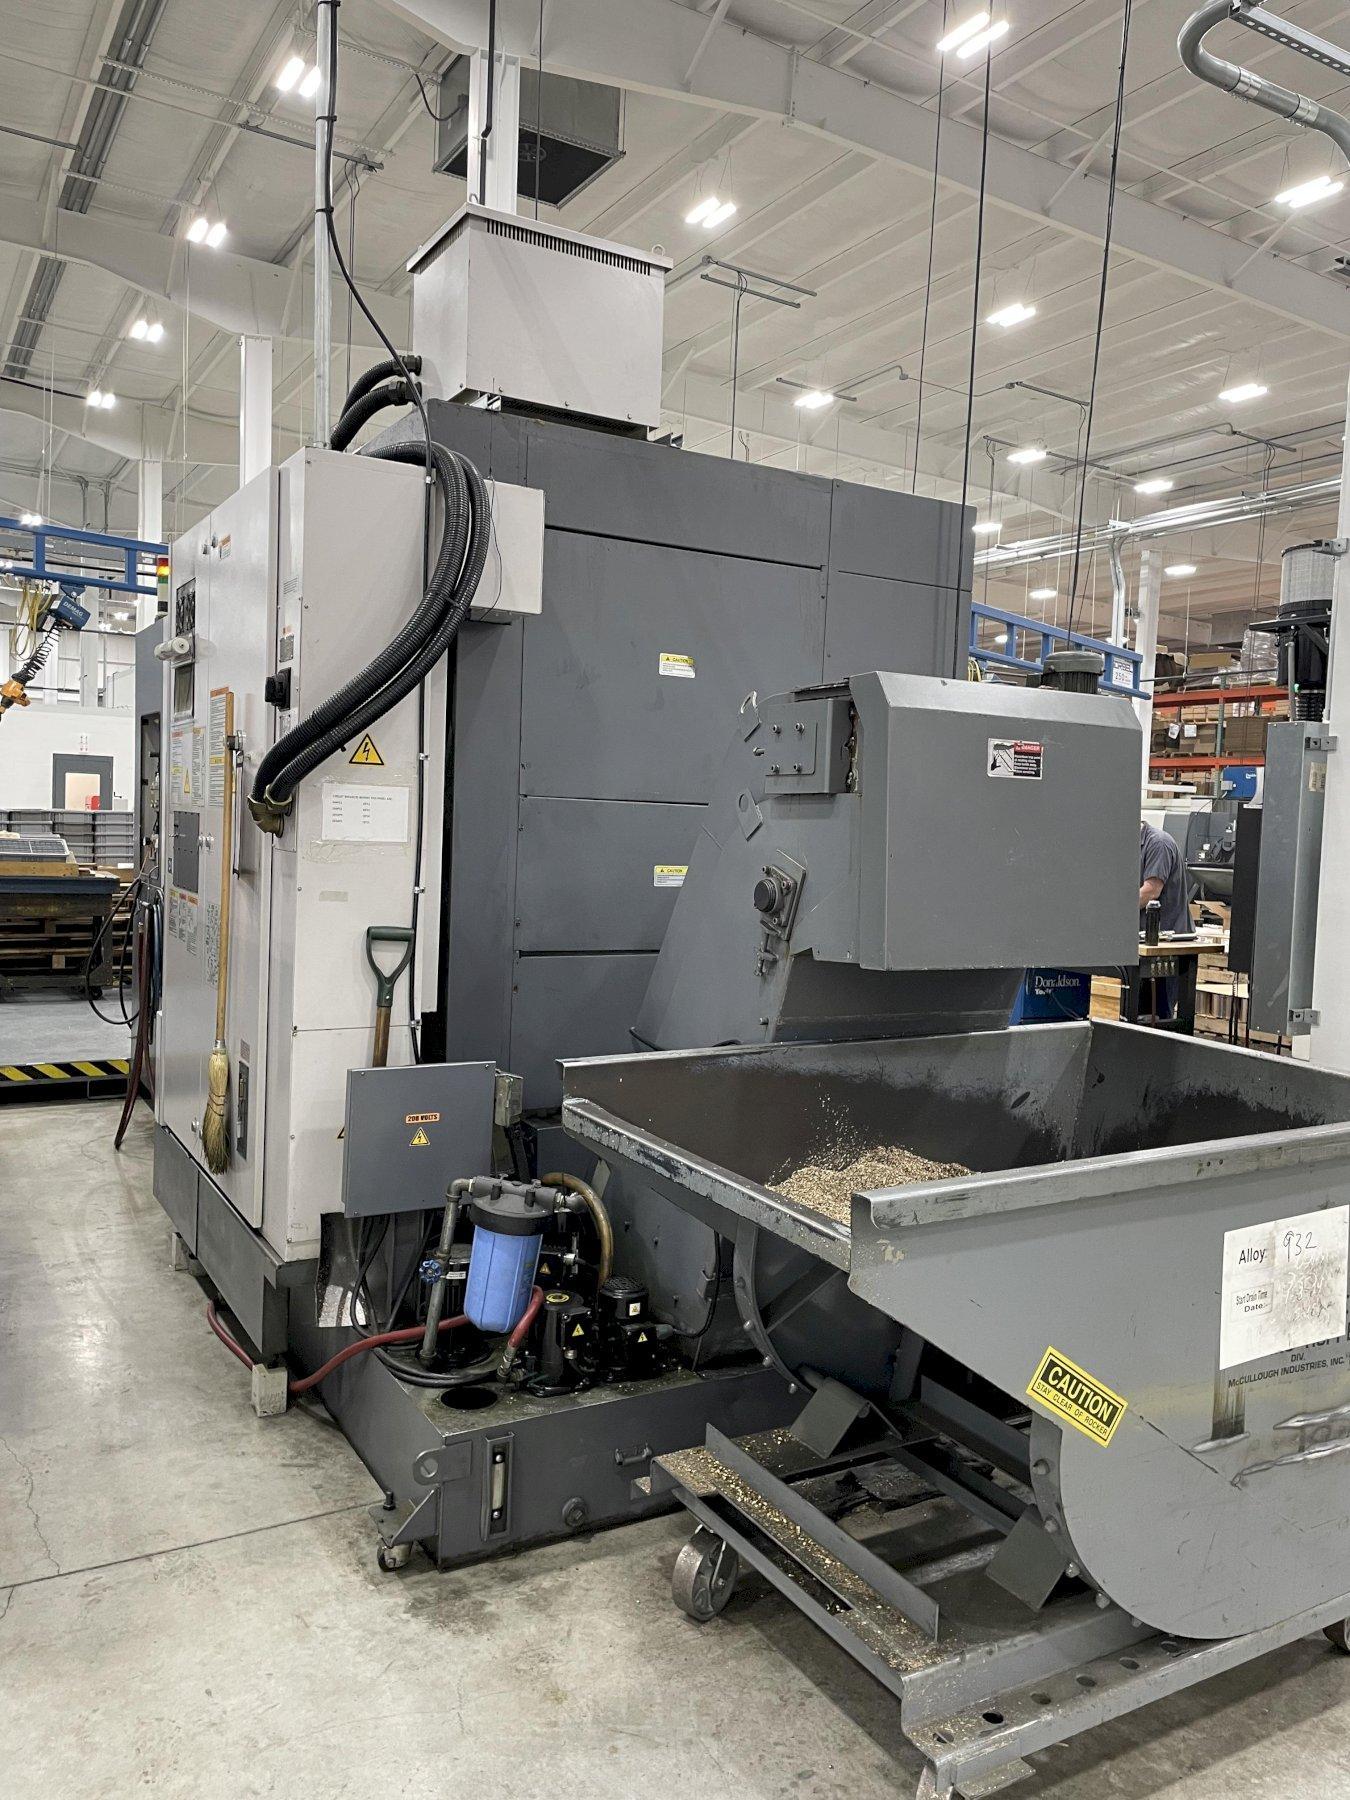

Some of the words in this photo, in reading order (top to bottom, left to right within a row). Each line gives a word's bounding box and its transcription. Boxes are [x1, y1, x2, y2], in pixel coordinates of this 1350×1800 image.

[63, 601, 84, 618] DEMAG
[1239, 1247, 1266, 1264] Alloy
[1283, 1230, 1318, 1262] 932
[1290, 1353, 1305, 1362] DIV.
[1228, 1369, 1279, 1388] McCULLOUGH
[1048, 1366, 1113, 1422] CAUTION
[1036, 1382, 1052, 1396] STAY
[1052, 1393, 1073, 1409] CLEAR
[1074, 1408, 1084, 1419] OF
[1084, 1415, 1108, 1436] ROCKER
